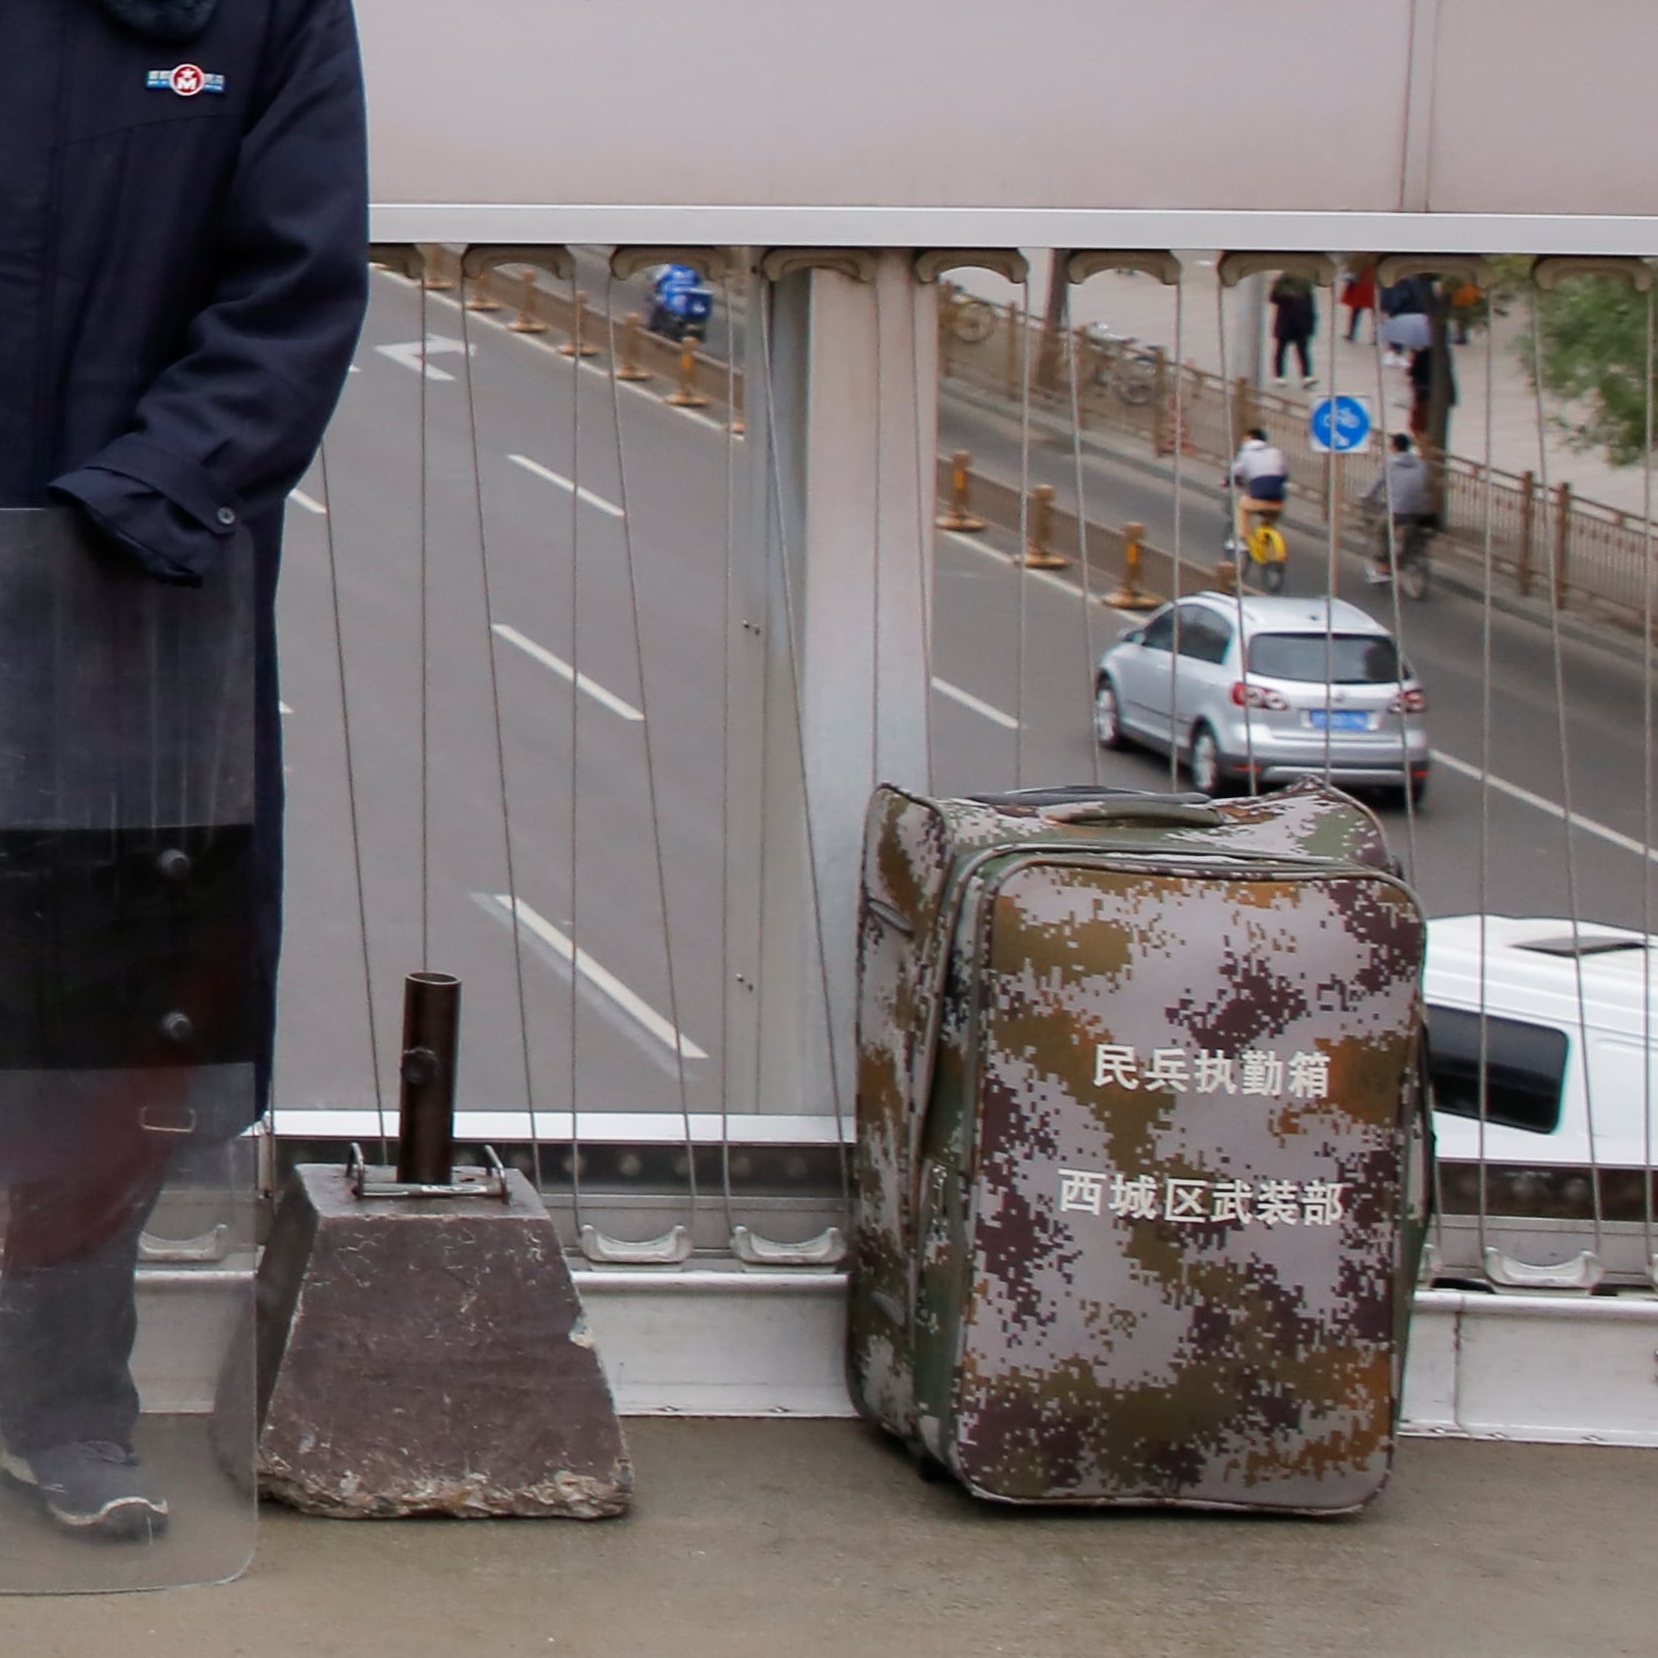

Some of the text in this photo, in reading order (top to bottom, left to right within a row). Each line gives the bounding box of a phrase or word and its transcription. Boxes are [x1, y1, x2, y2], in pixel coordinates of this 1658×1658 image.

[1093, 1044, 1332, 1098] 民兵执勤箱
[1057, 1168, 1354, 1227] 西城区武装部
